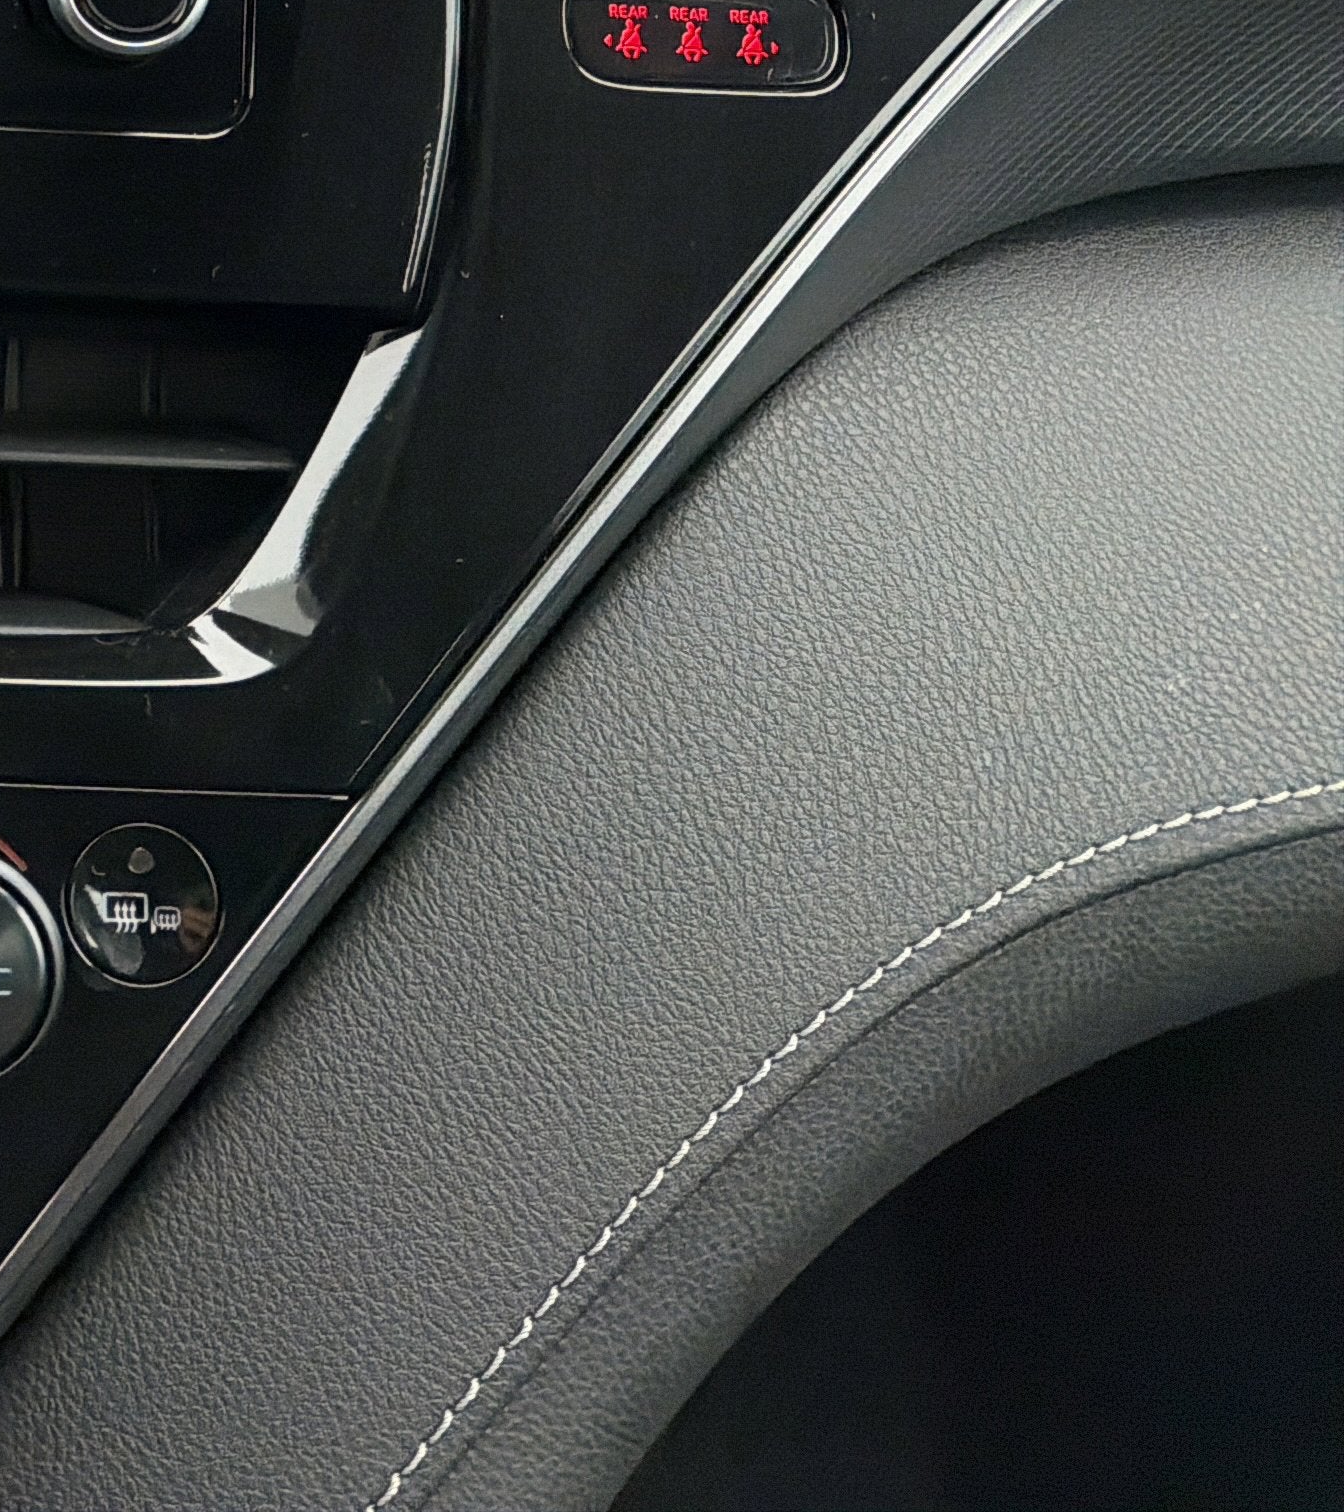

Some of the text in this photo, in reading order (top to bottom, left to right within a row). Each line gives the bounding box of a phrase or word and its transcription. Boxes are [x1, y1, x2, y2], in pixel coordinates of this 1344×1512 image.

[608, 3, 769, 25] REAR REAR REAR
